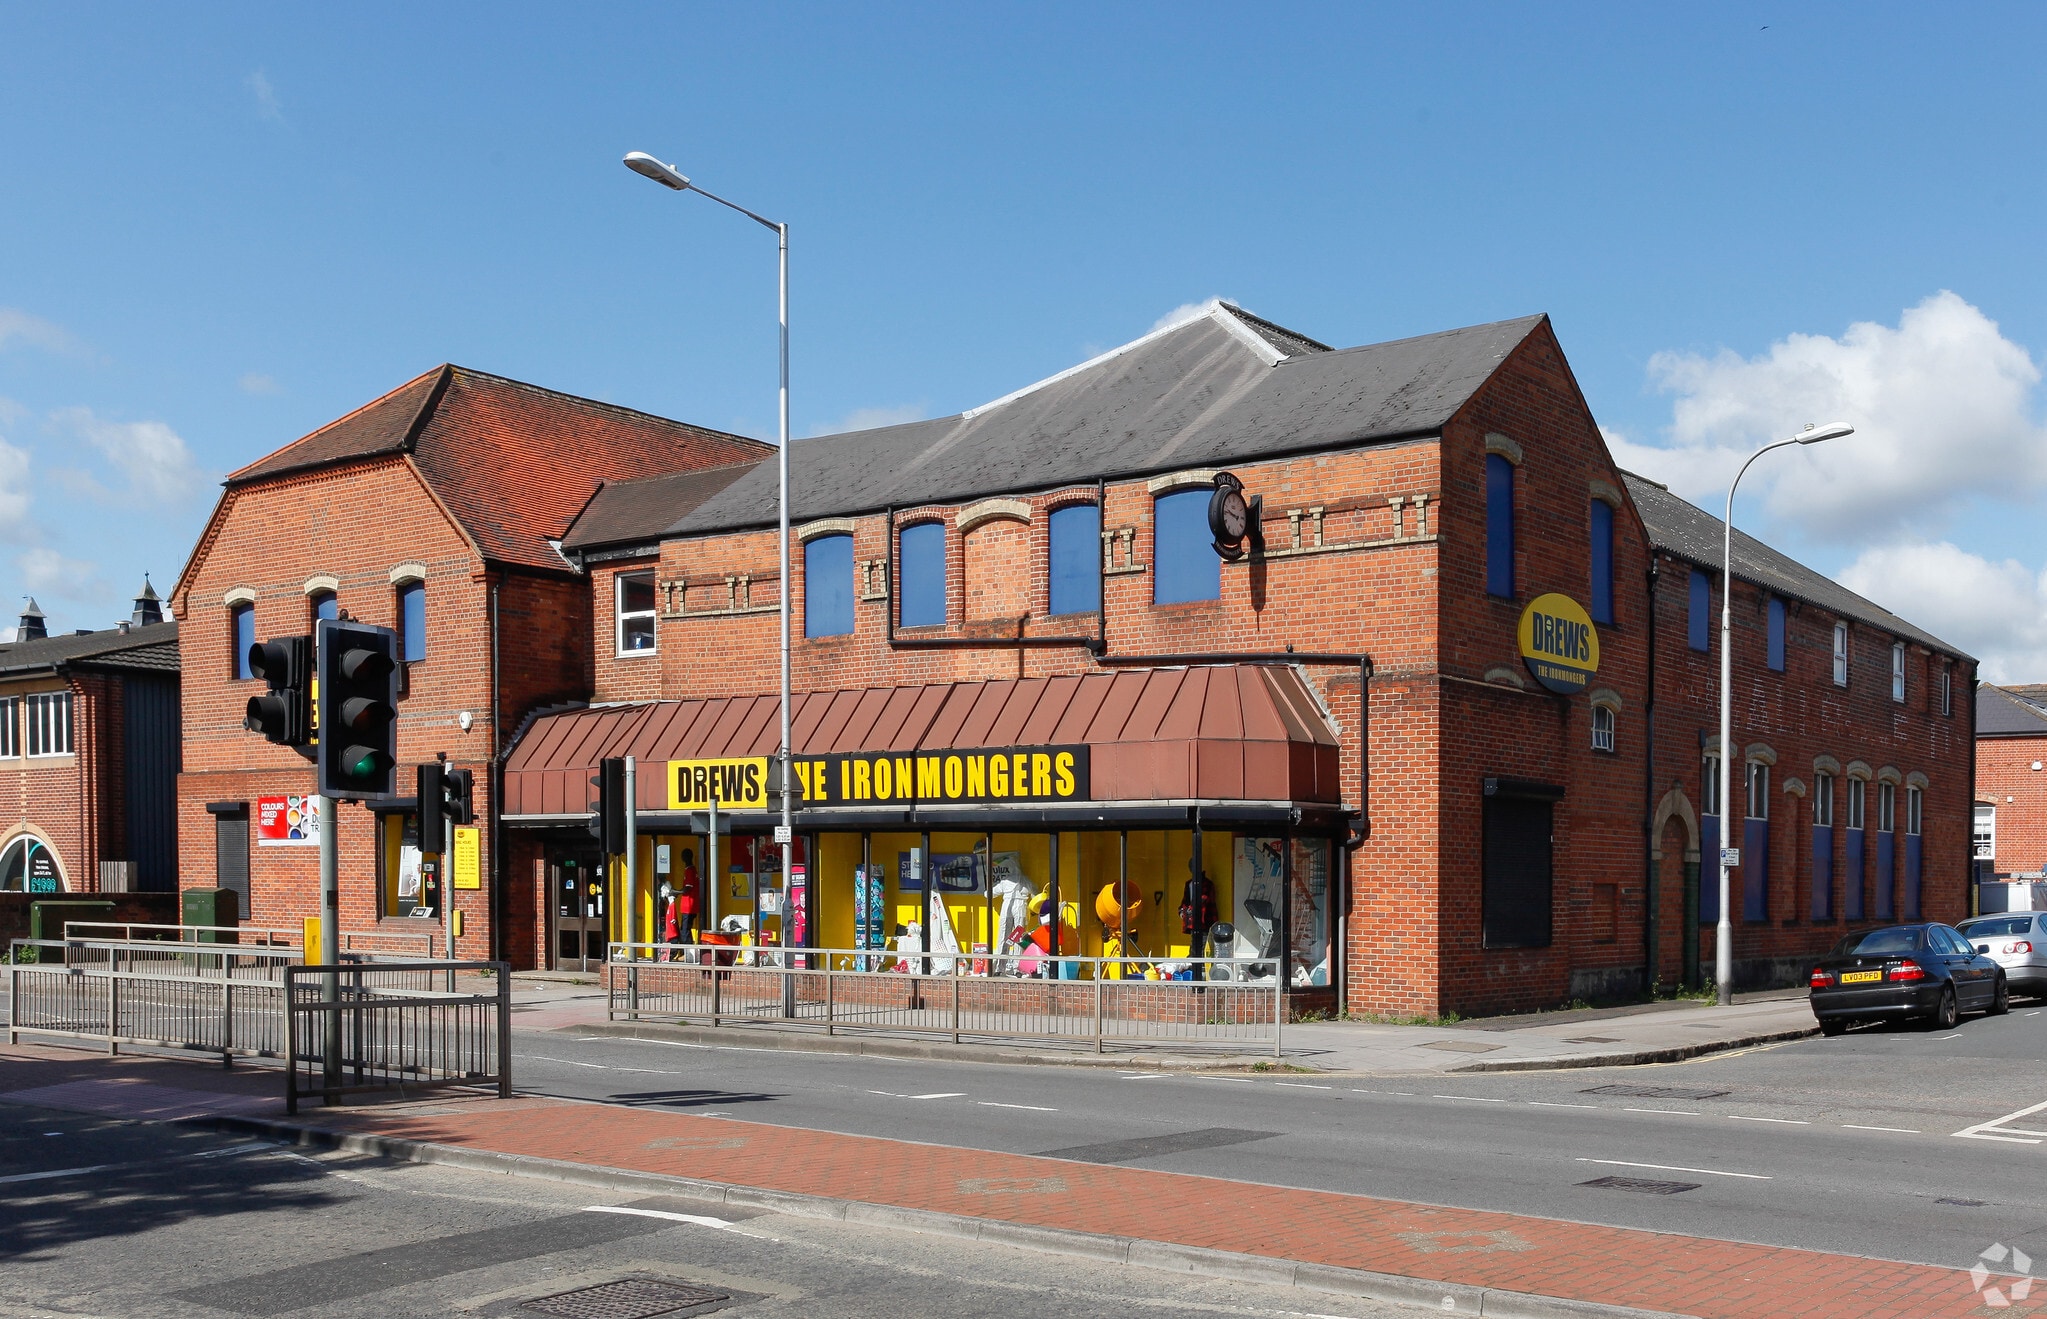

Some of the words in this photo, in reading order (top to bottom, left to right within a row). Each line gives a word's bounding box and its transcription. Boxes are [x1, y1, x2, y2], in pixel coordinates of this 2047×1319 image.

[1216, 474, 1240, 490] DREWS
[1532, 611, 1590, 662] DREWS
[1537, 664, 1548, 677] THE
[1549, 668, 1586, 686] IRONMONGERS
[678, 763, 760, 803] DREWS
[841, 751, 1075, 800] IRONMONGERS
[260, 802, 285, 811] COLOURS
[260, 818, 275, 826] HERE
